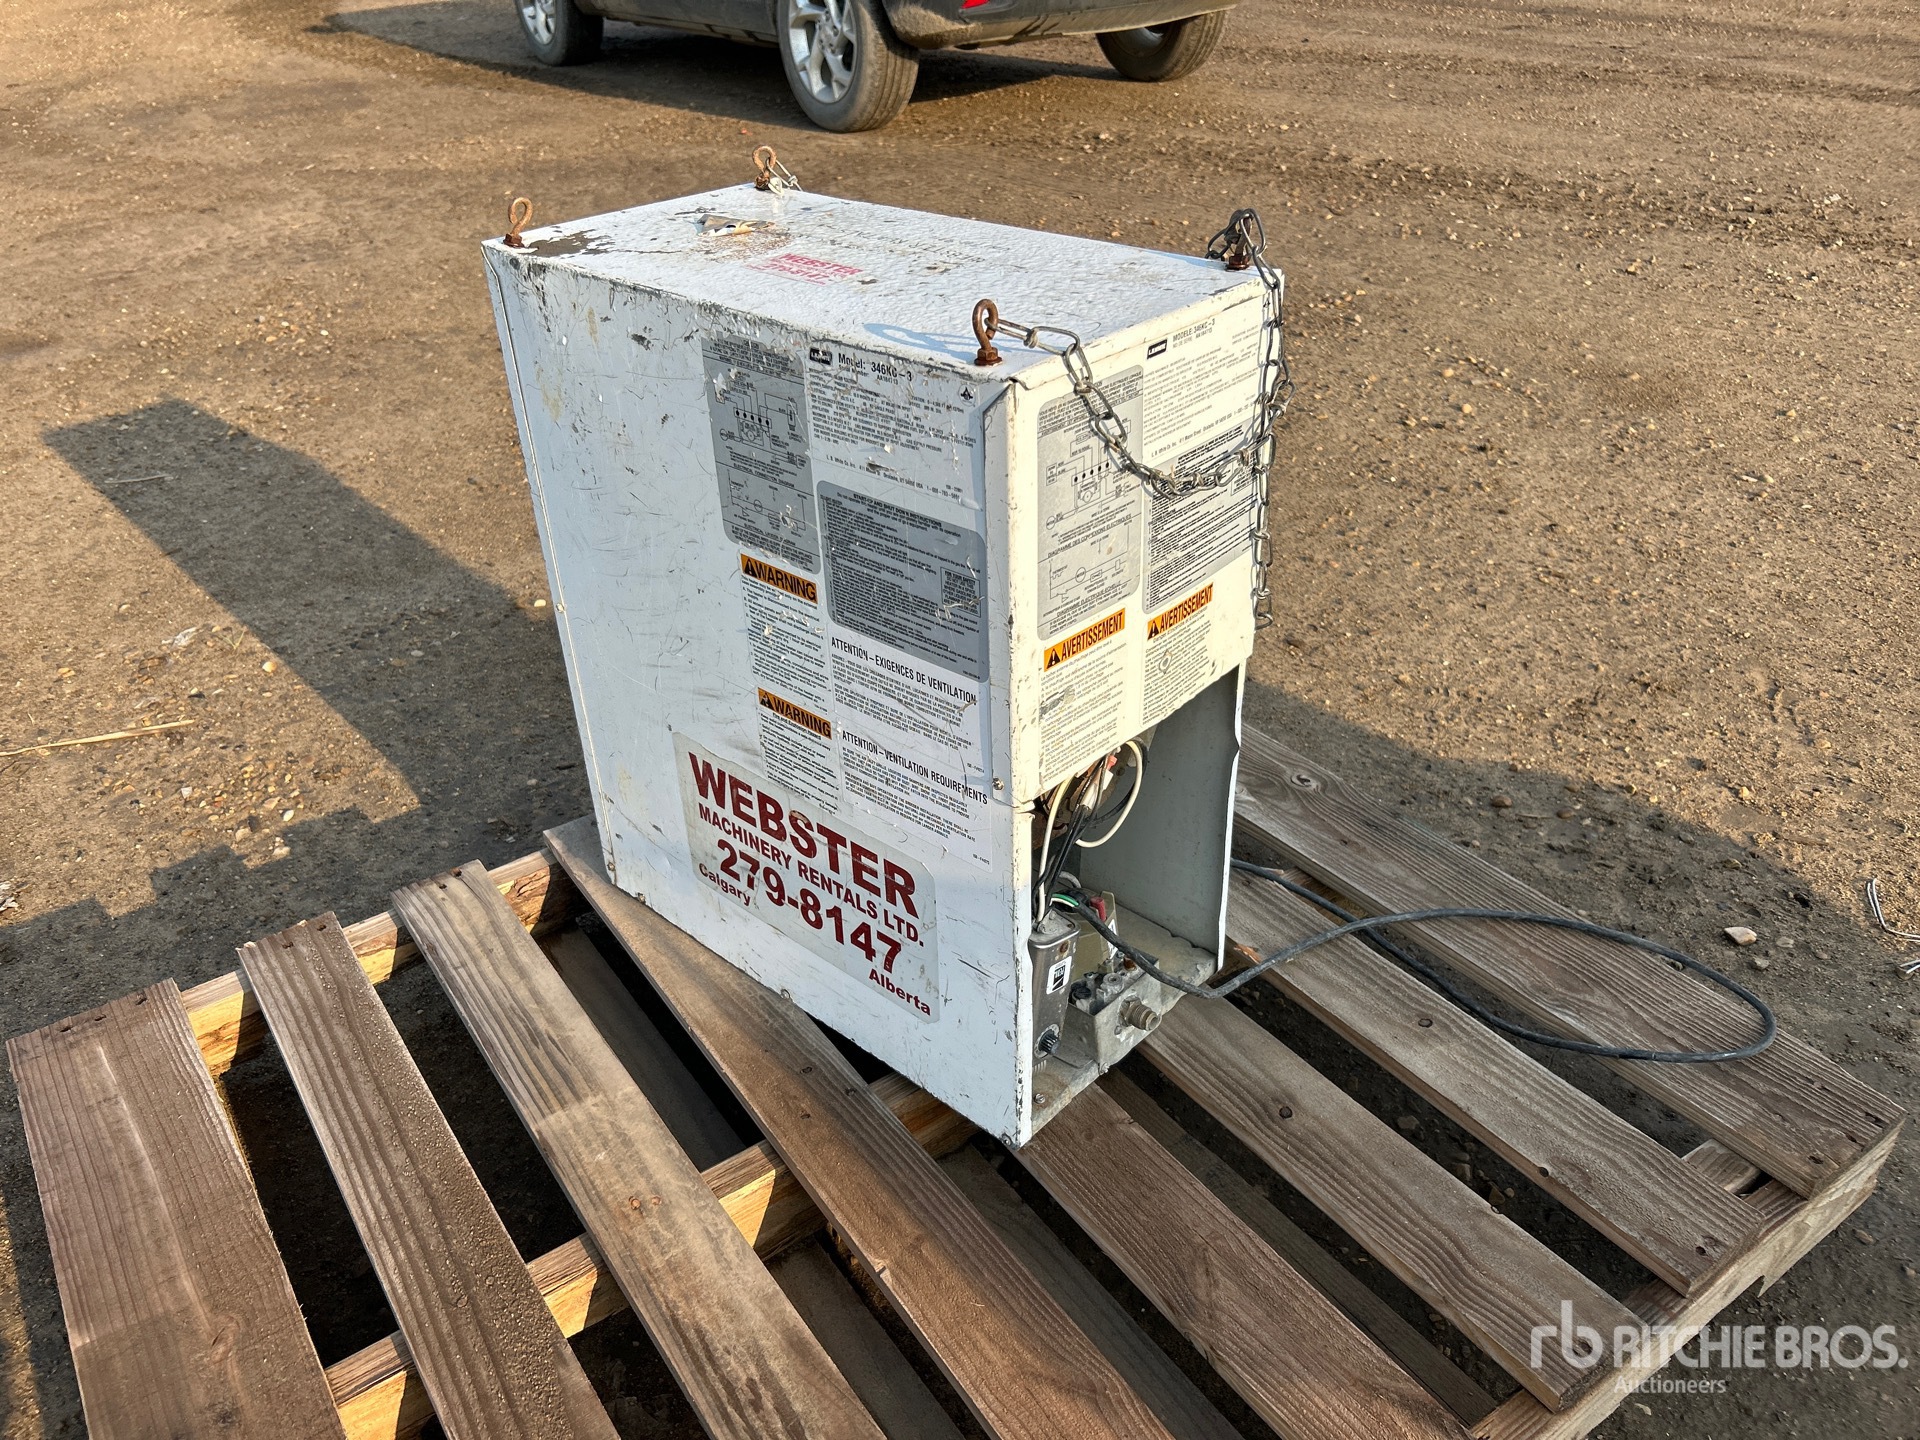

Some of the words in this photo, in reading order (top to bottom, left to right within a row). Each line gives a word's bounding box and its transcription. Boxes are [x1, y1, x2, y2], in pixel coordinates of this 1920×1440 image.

[754, 560, 816, 600] WARNING
[1160, 584, 1214, 632] AVERTISSEMENT
[1062, 610, 1124, 661] AVERTISSEMENT
[916, 671, 926, 684] DE
[928, 675, 977, 705] VENTILATION
[774, 698, 831, 739] WARNING
[931, 770, 987, 804] REQUIREMENTS
[689, 752, 919, 919] WEBSTER
[698, 802, 792, 869] MACHINERY
[798, 860, 878, 920] RENTALS
[884, 910, 925, 947] LTD.
[699, 862, 750, 906] Calgary
[717, 839, 902, 974] 279-8147
[869, 969, 931, 1016] Alberta
